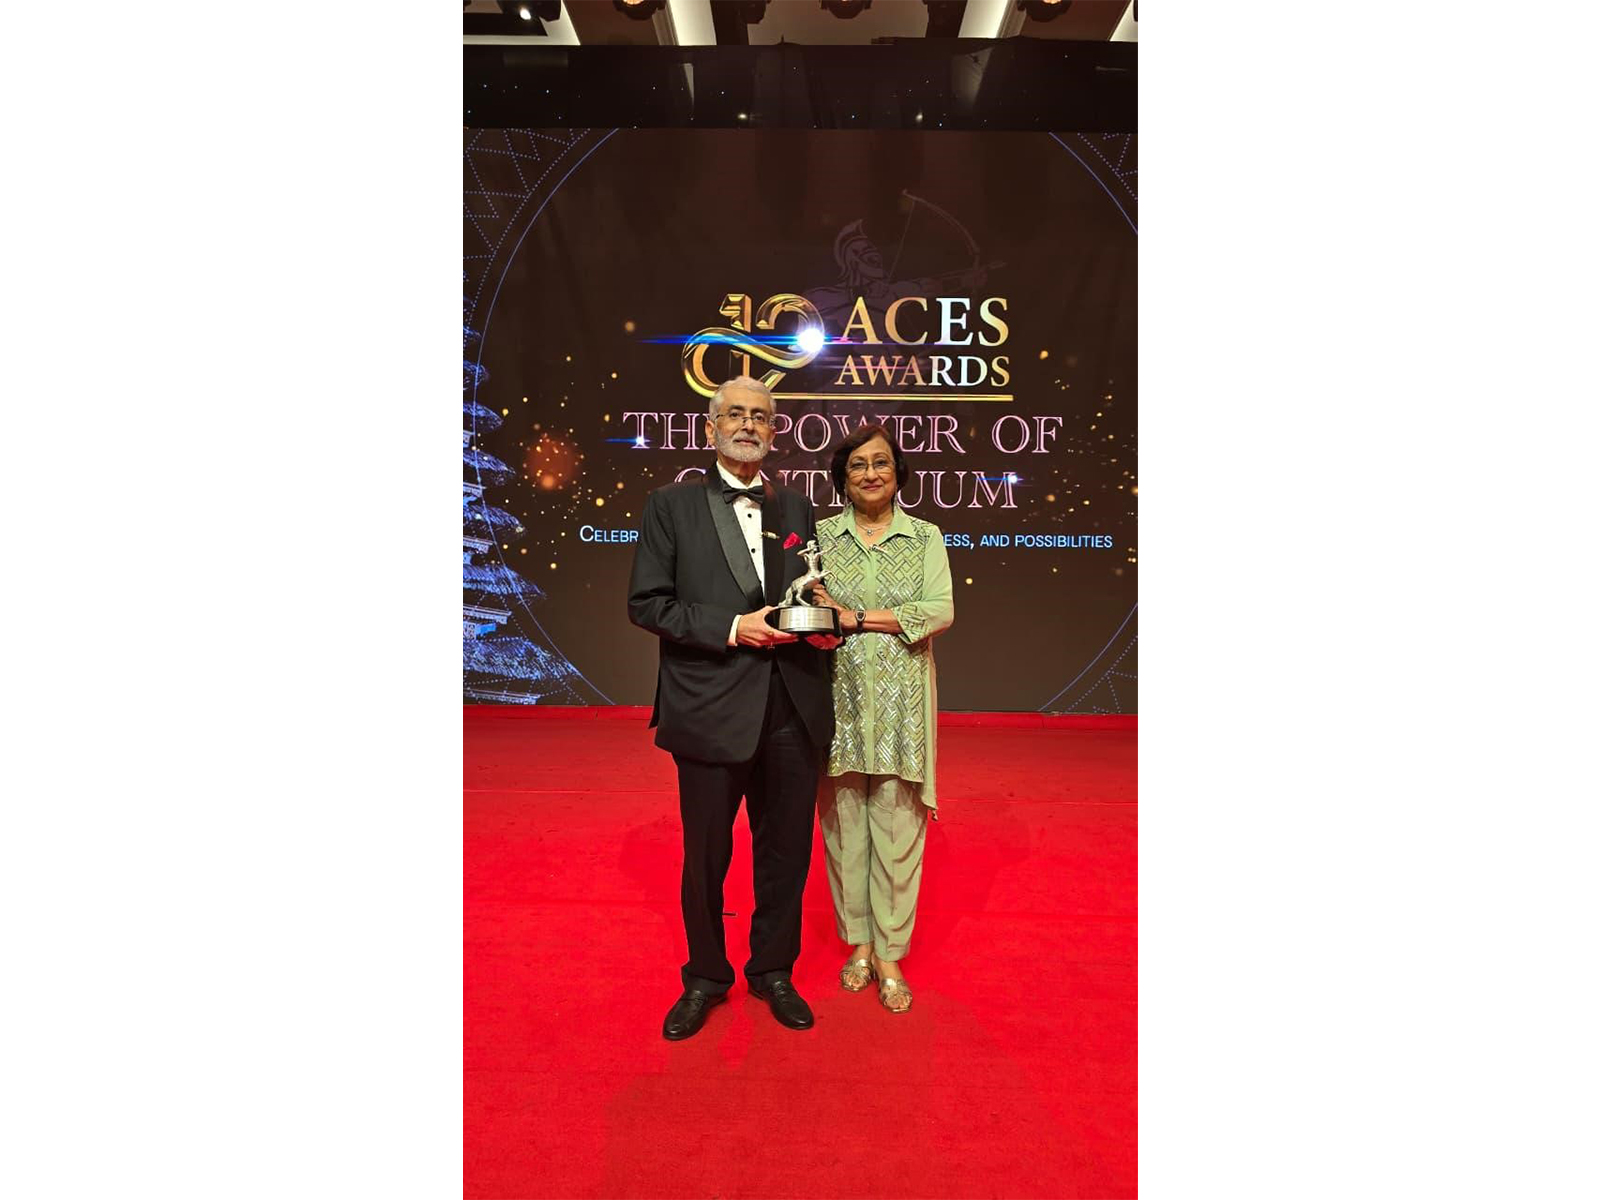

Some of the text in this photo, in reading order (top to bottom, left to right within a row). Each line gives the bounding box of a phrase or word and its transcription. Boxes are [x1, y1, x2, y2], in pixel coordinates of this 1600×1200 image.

[838, 296, 1009, 347] ACES
[834, 355, 1010, 387] AWARDS
[991, 415, 1063, 453] OF
[579, 525, 1113, 550] CELEBR ESS, AND POSSIBILITIES
